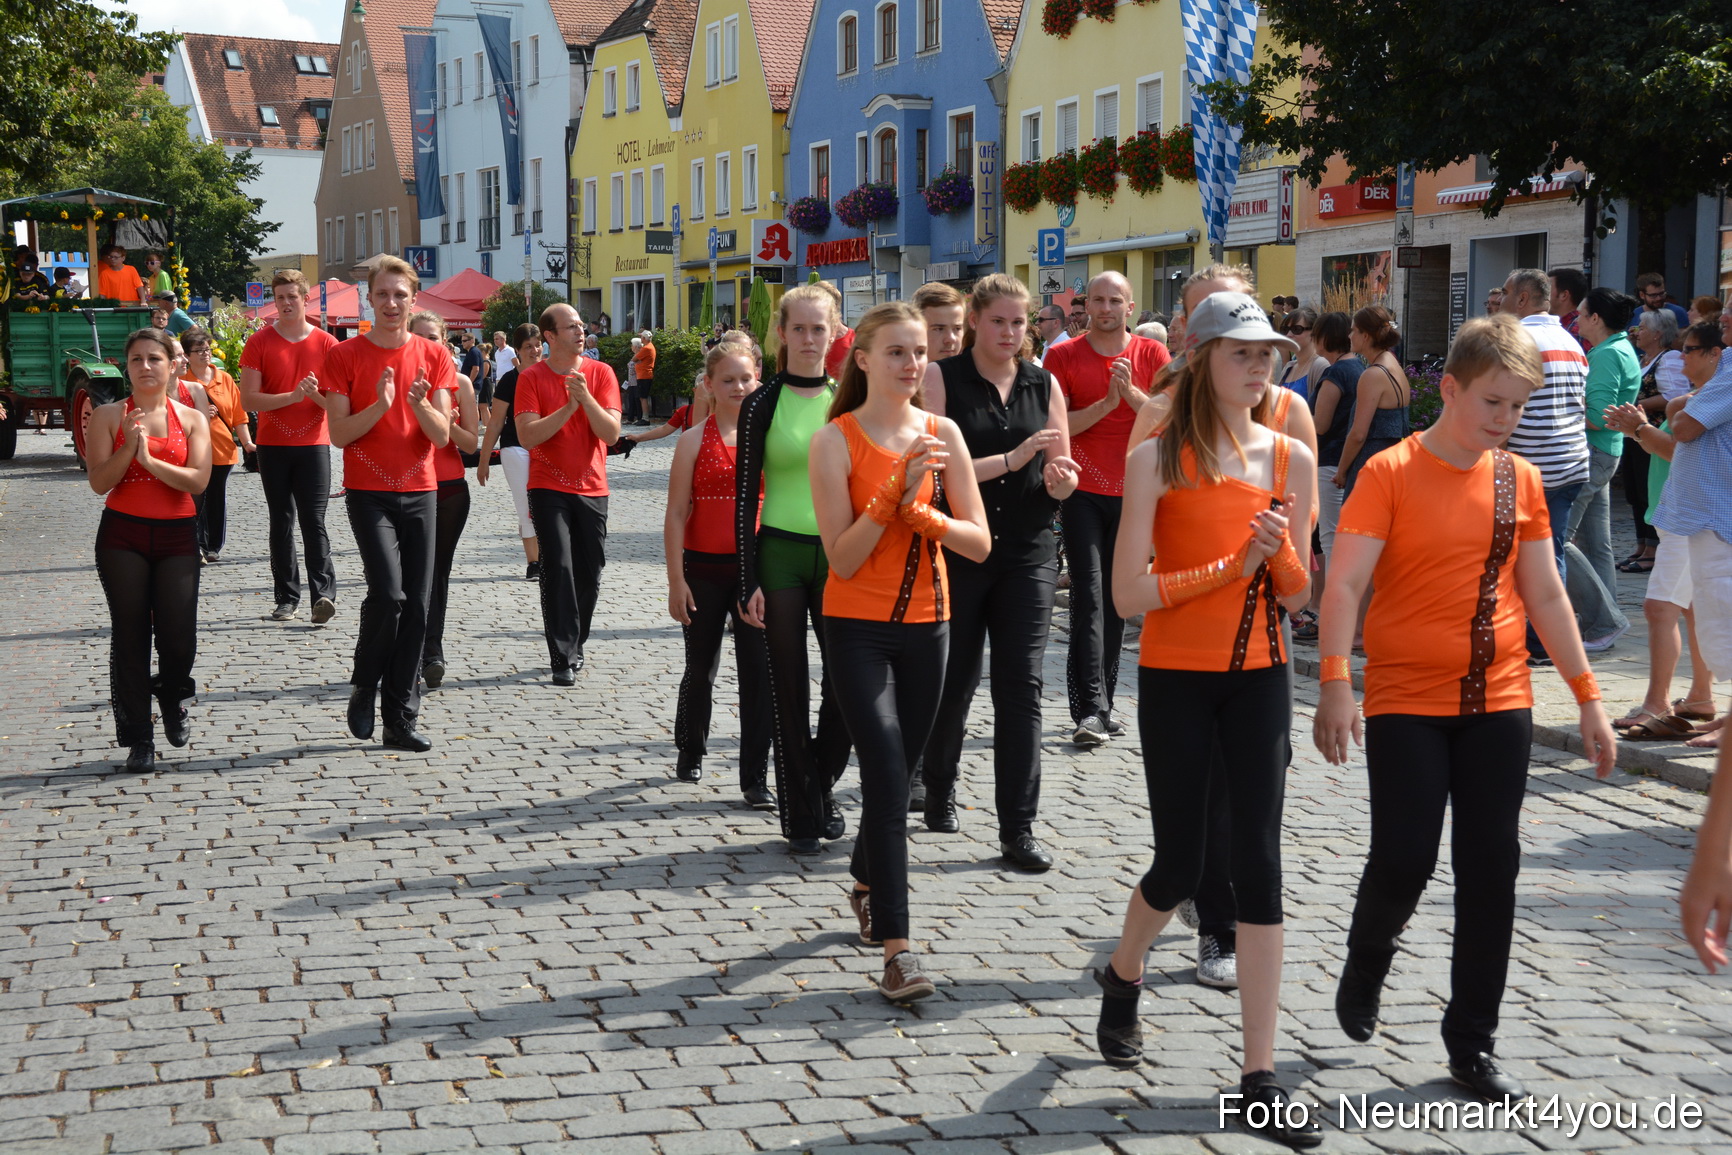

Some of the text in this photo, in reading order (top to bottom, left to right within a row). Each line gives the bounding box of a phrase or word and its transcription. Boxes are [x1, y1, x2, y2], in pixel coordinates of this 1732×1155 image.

[616, 135, 676, 164] HOTEL Lehmeier
[979, 143, 996, 158] CAFÉ
[980, 161, 994, 236] WITTL
[1282, 170, 1291, 238] KINO
[1364, 186, 1390, 199] DER
[1252, 199, 1268, 214] KINO
[1320, 197, 1334, 213] DER
[804, 237, 870, 267] APOTHEKE
[1044, 233, 1058, 262] P
[615, 255, 650, 272] Restaurant
